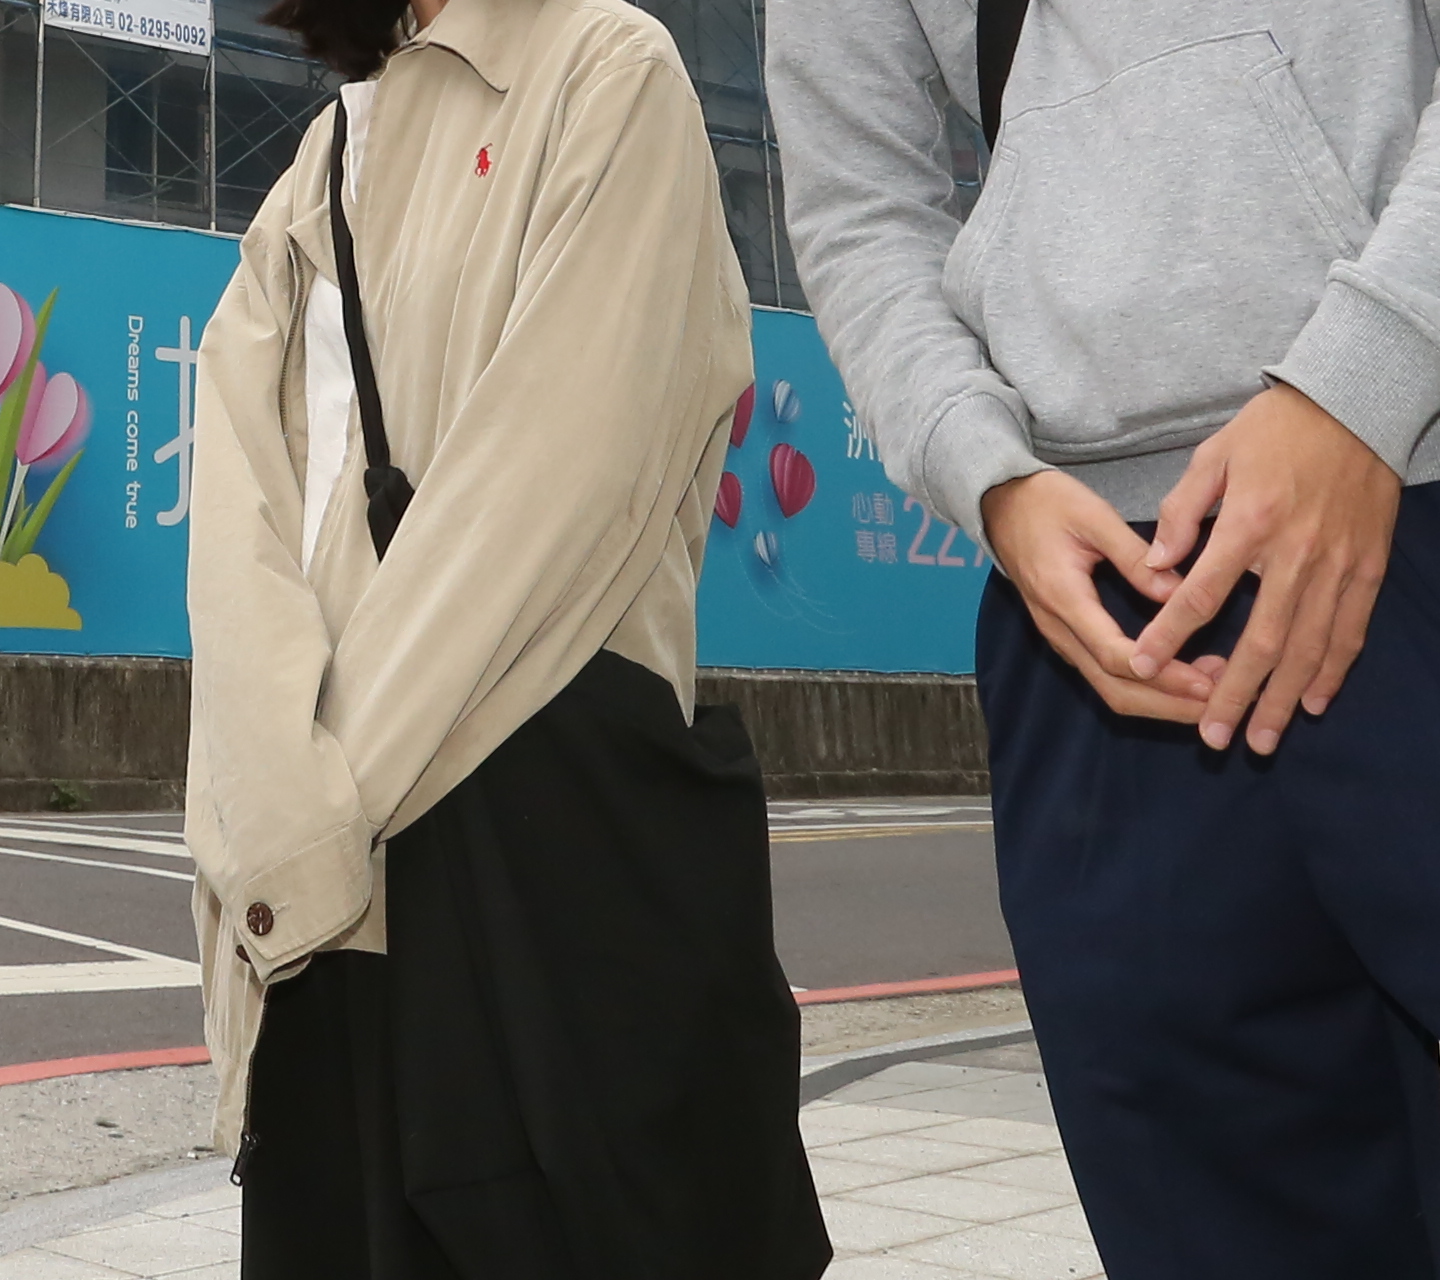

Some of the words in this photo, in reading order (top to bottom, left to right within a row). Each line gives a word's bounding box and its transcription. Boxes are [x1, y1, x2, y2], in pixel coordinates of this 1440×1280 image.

[118, 12, 207, 46] 02-8295-0092
[126, 314, 144, 402] Dreams
[125, 410, 140, 472] come
[124, 480, 142, 529] true
[852, 492, 895, 525] 心動
[903, 496, 986, 568] 22
